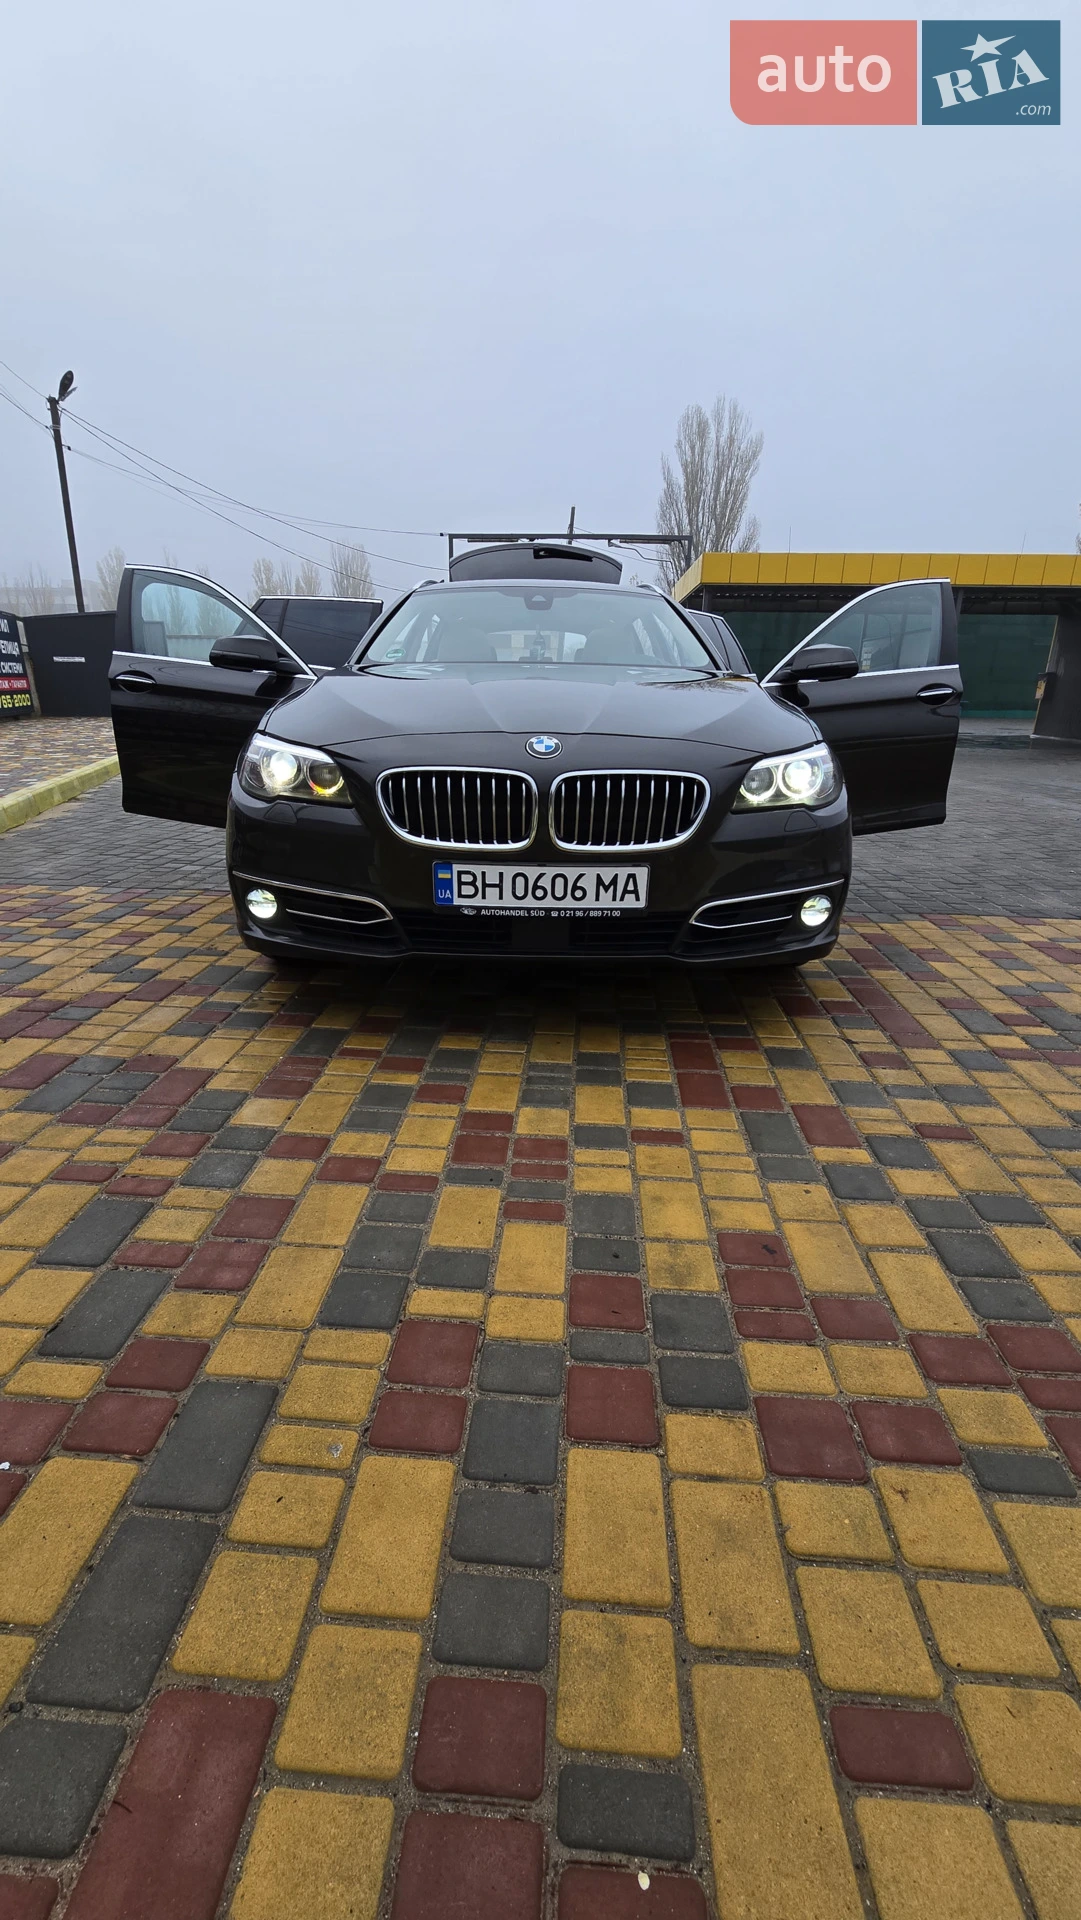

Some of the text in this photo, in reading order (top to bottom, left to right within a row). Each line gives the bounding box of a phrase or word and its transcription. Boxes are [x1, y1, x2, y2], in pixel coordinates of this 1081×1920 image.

[438, 889, 452, 899] UA
[480, 908, 529, 917] AUTOHANDEL
[530, 908, 546, 917] SÜD
